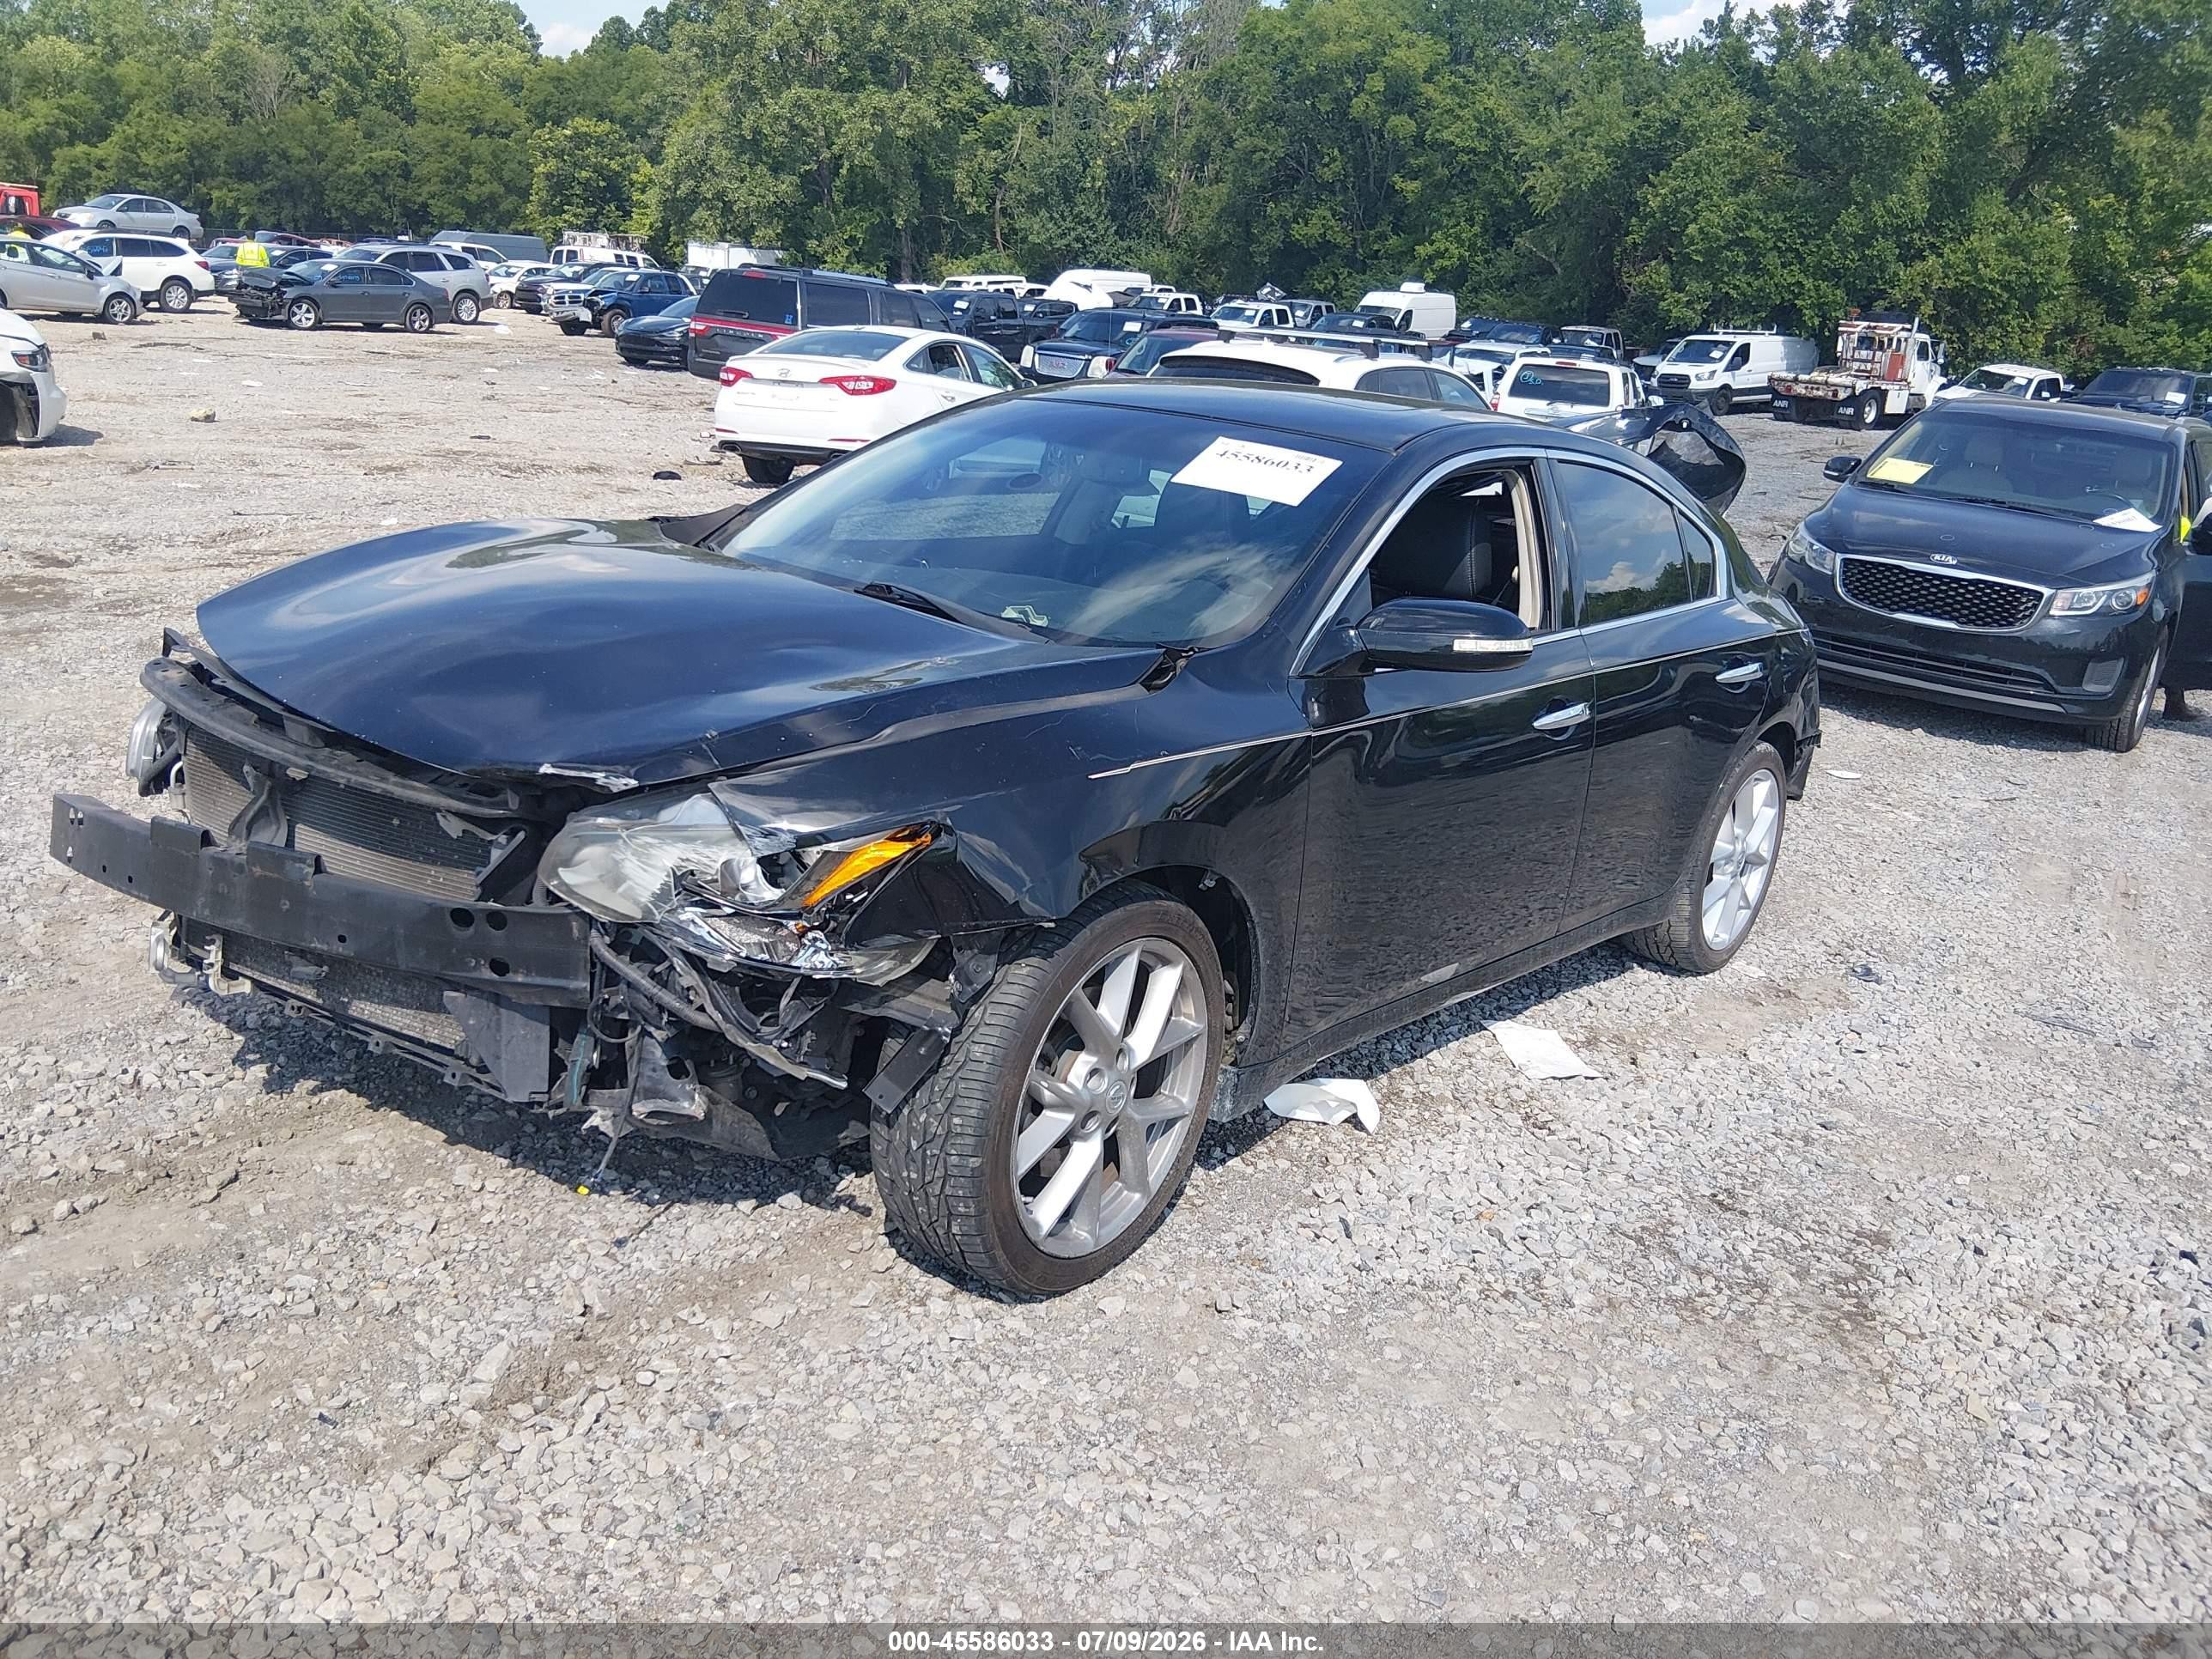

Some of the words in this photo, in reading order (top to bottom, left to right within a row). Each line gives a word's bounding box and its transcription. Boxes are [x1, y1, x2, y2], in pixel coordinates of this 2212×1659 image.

[1772, 399, 1789, 408] ANR
[1838, 406, 1855, 416] ANR
[1216, 449, 1315, 473] 45586033
